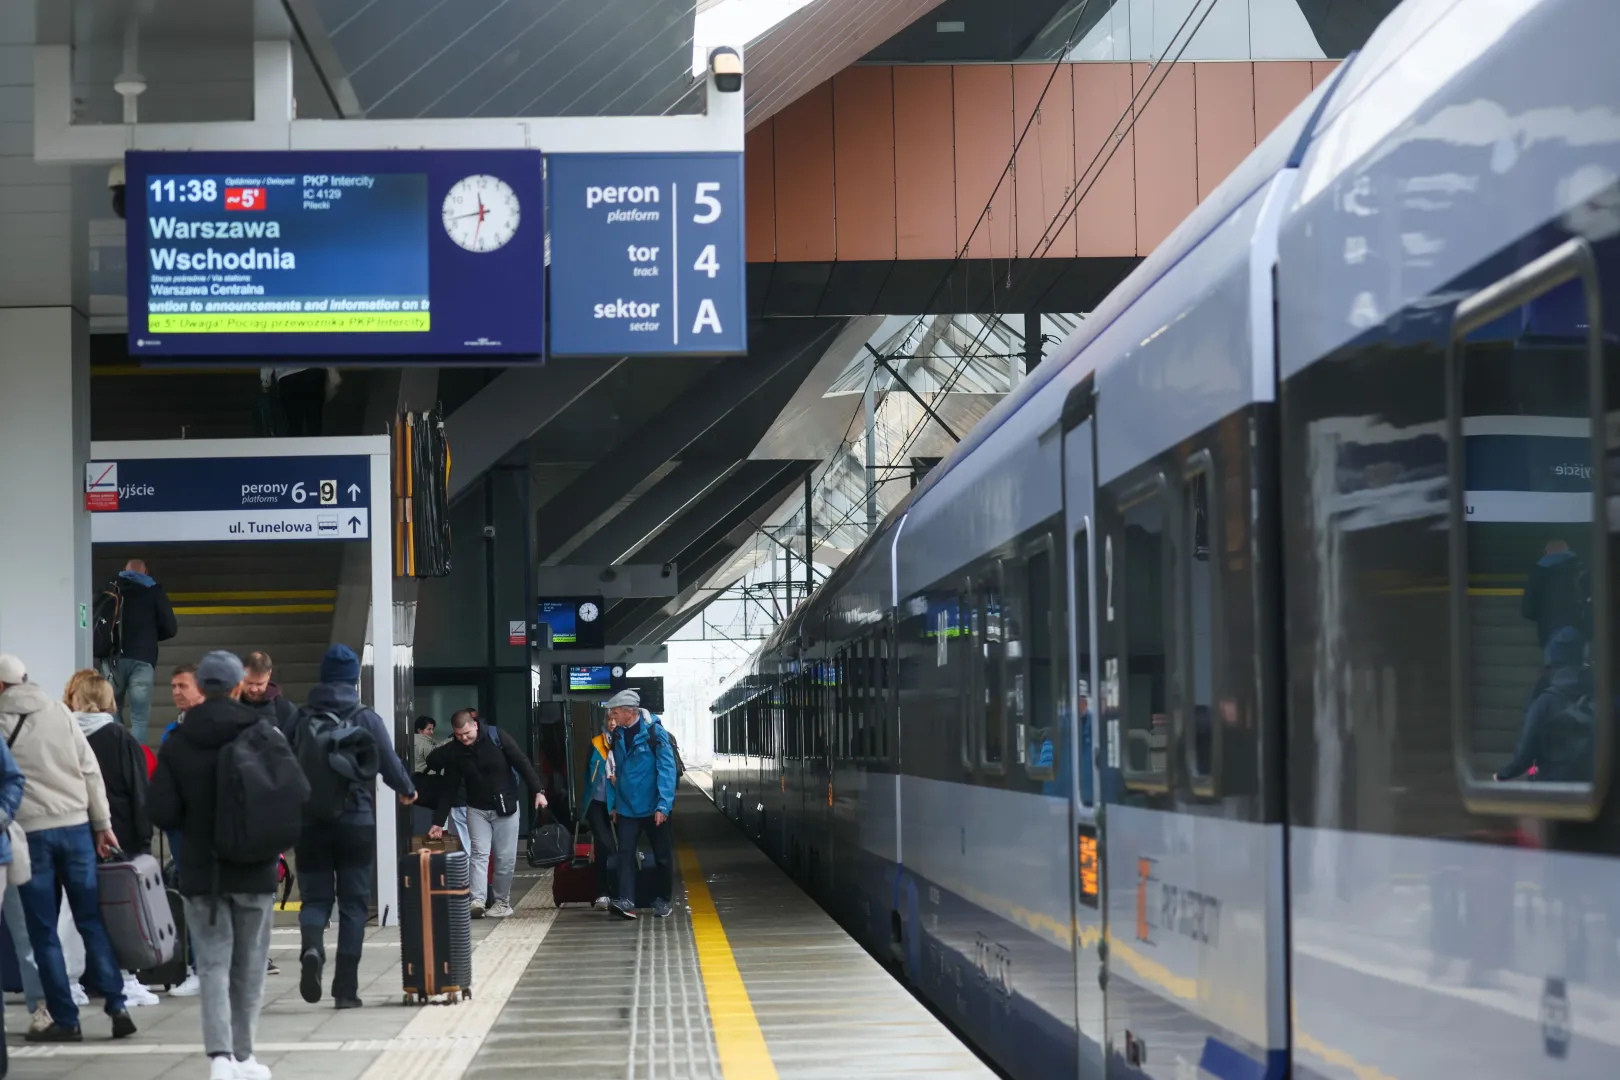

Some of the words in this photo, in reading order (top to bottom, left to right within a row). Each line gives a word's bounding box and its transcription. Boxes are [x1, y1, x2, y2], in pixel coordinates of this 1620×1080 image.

[302, 175, 328, 187] PKP
[330, 175, 375, 189] Intercity
[149, 179, 218, 202] 11:38
[303, 189, 314, 200] IC
[316, 189, 342, 200] 4129
[586, 186, 660, 208] peron
[693, 182, 722, 224] 5
[606, 208, 660, 224] platform
[149, 216, 281, 239] Warszawa
[150, 247, 296, 270] Wschodnia
[627, 244, 660, 262] tor
[693, 244, 720, 278] 4
[633, 266, 659, 277] track
[150, 284, 208, 296] Warszawa
[210, 283, 265, 296] Centralna
[148, 300, 188, 312] ention
[190, 301, 203, 312] to
[205, 300, 302, 312] announcements
[304, 298, 328, 311] and
[330, 298, 400, 310] information
[402, 300, 419, 310] on
[348, 318, 376, 327] PKP
[594, 298, 660, 318] sektor
[692, 298, 723, 334] A
[629, 322, 660, 332] sector
[118, 484, 154, 498] yjście
[242, 484, 288, 496] perony
[242, 495, 278, 504] platforms
[230, 522, 244, 534] ul.
[248, 521, 312, 533] Tunelowa
